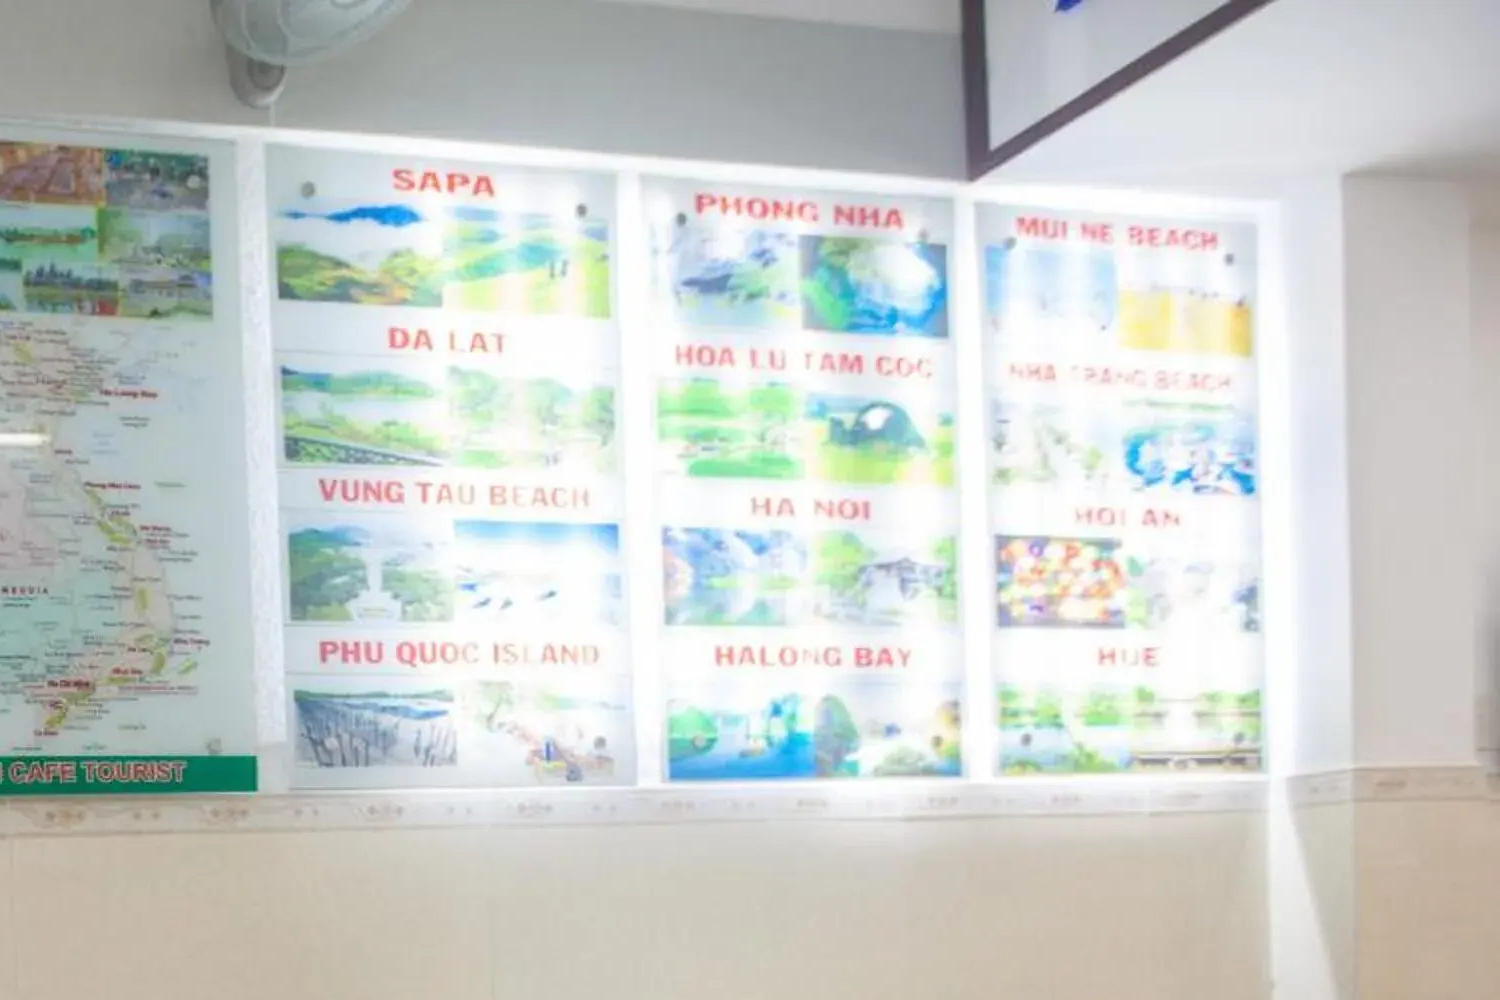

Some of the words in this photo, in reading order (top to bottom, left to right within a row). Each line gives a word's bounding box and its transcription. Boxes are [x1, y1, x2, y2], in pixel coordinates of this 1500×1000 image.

[392, 168, 495, 198] SAPA
[693, 193, 819, 222] PHONG
[833, 204, 905, 230] NHA
[1015, 216, 1068, 239] MUI
[1129, 226, 1219, 251] BEACH
[387, 327, 434, 351] DA
[449, 331, 507, 354] LAT
[675, 345, 736, 368] HOA
[804, 351, 864, 376] TAM
[318, 478, 406, 504] VUNG
[415, 482, 476, 505] TAU
[489, 484, 590, 508] BEACH
[750, 496, 796, 517] HA
[814, 498, 871, 521] NOI
[319, 640, 384, 665] PHU
[396, 641, 480, 668] QUOC
[493, 641, 599, 665] ISLAND
[714, 645, 842, 668] HALONG
[854, 646, 912, 668] BAY
[1098, 646, 1161, 667] HUE
[10, 761, 77, 784] CAFE
[85, 761, 186, 783] TOURIST
